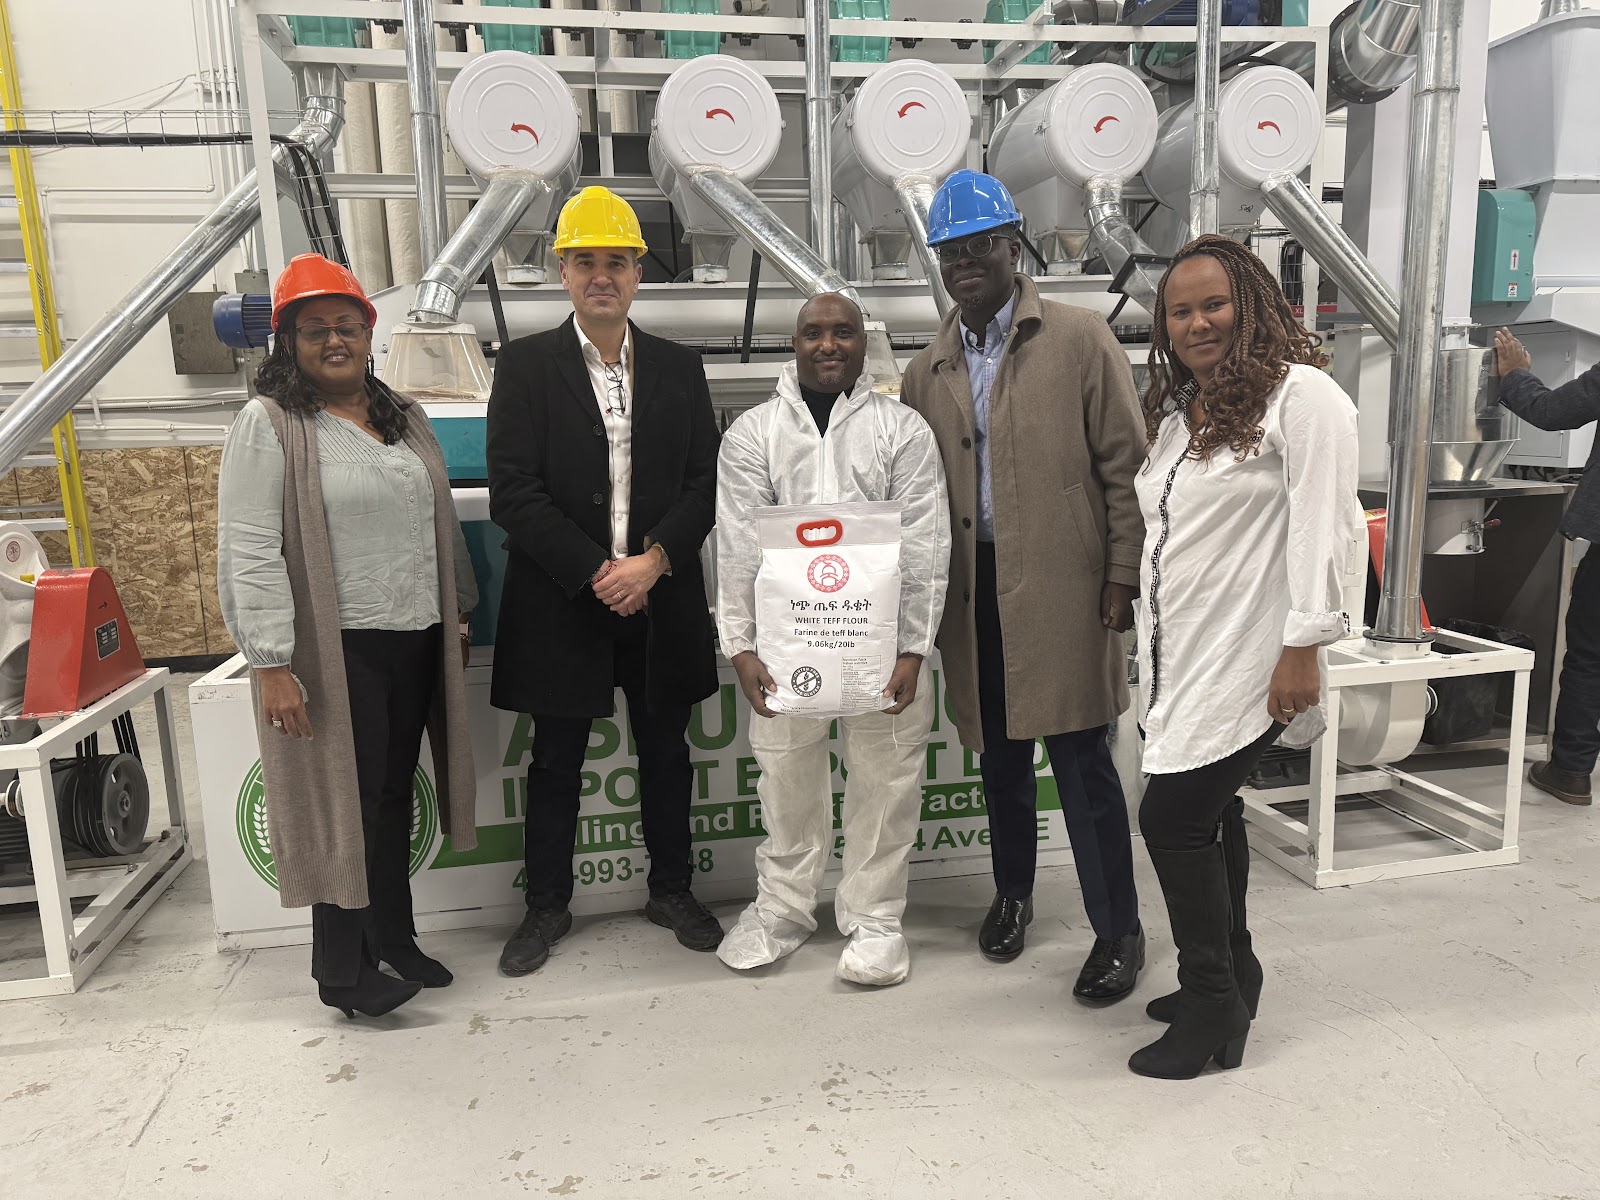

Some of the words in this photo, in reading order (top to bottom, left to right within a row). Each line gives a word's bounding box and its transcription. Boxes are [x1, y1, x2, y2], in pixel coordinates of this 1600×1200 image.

[790, 599, 810, 611] ነጭ
[814, 600, 838, 611] ጤፍ
[795, 616, 821, 624] WHITE
[822, 617, 841, 625] TEFF
[842, 617, 869, 625] FLOUR
[794, 628, 819, 636] Farine
[820, 629, 830, 637] de
[832, 629, 846, 637] teff
[847, 629, 869, 637] blanc
[807, 640, 856, 650] 9.06kg/20lb
[690, 807, 734, 833] nd
